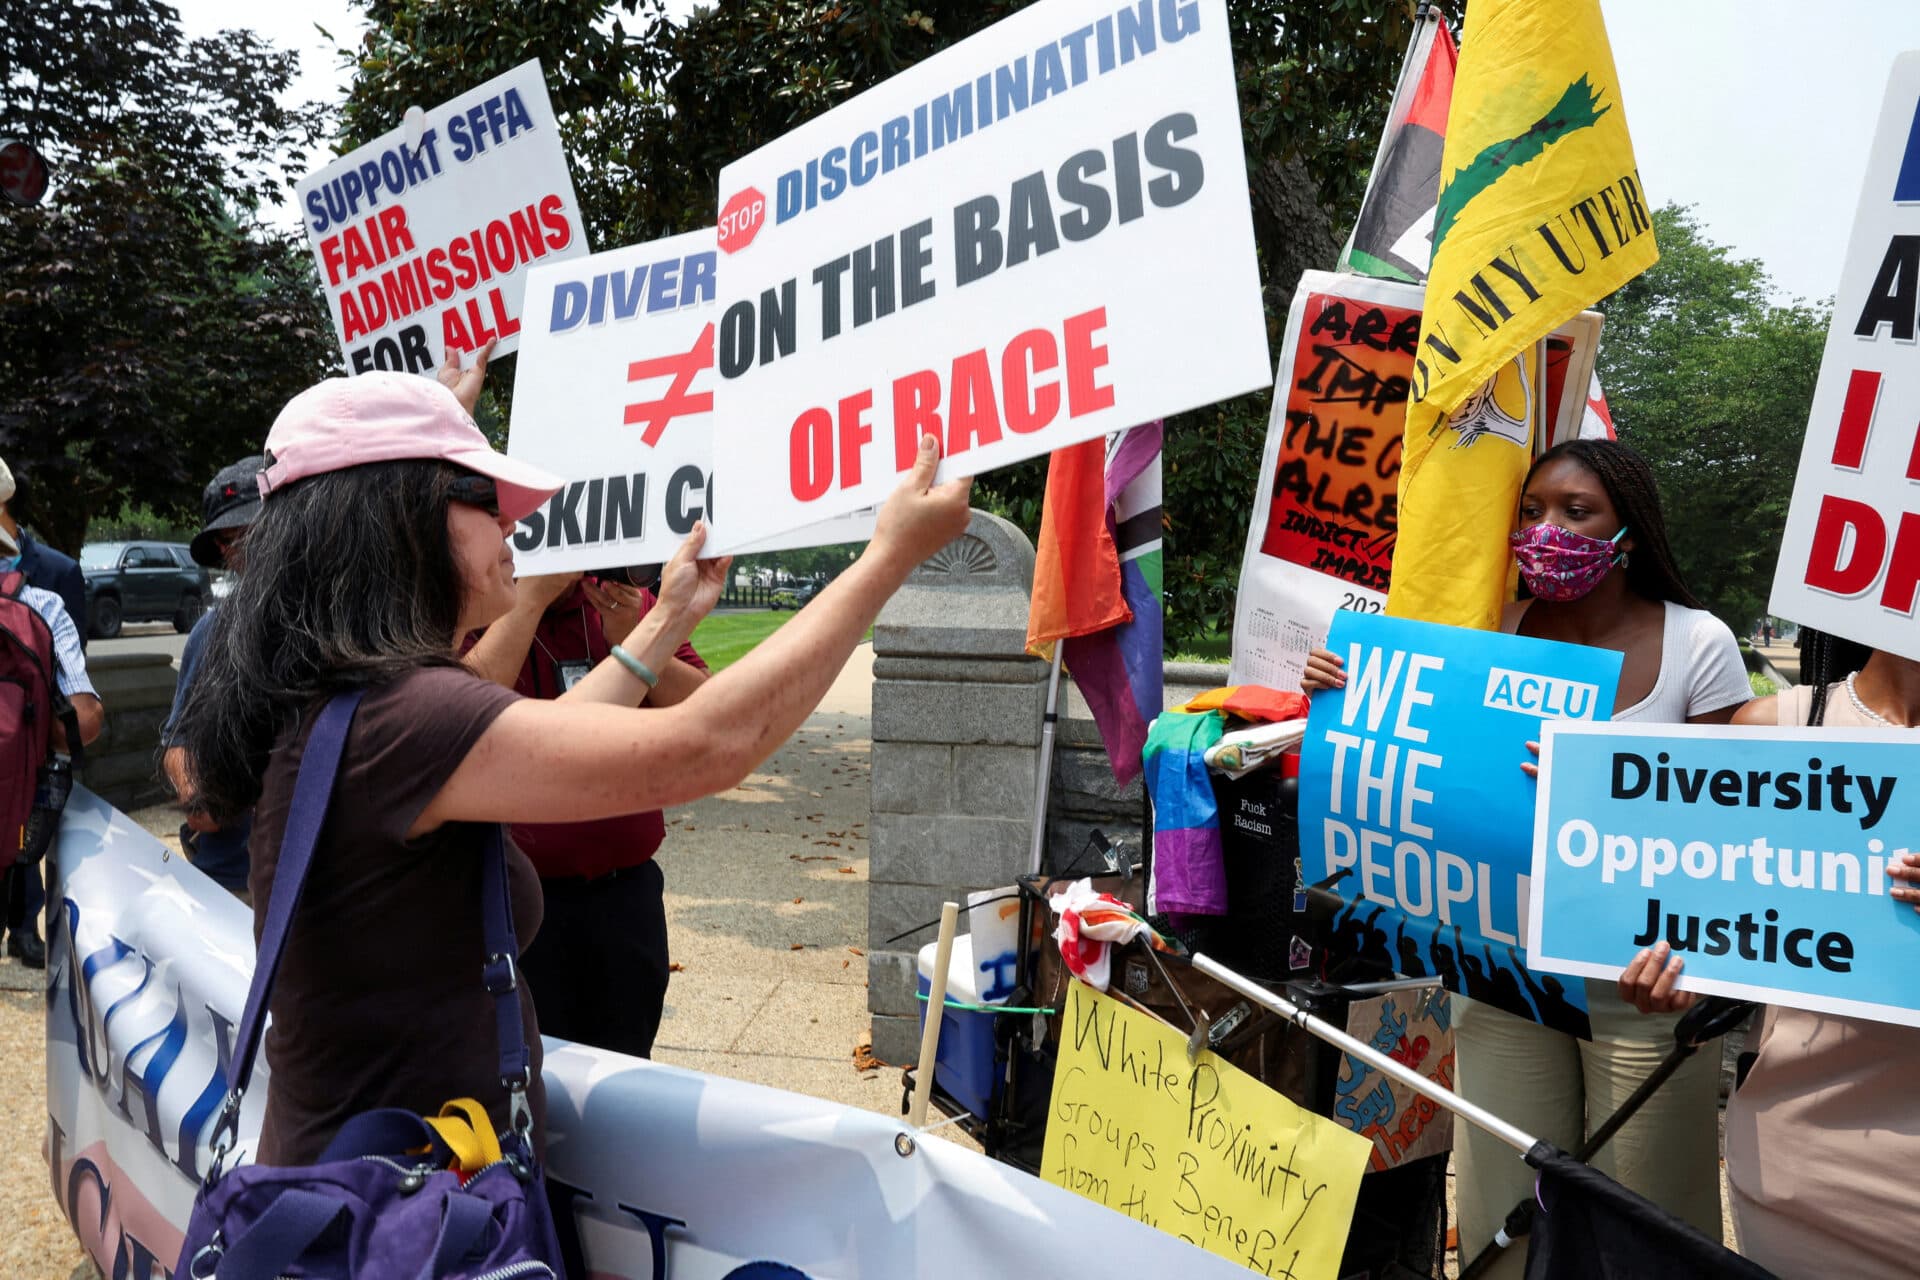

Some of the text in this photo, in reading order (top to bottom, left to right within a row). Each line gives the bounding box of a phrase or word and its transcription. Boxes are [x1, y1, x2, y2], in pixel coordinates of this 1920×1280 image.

[306, 87, 534, 233] SUPPORT SFFA
[719, 0, 1200, 241] STOP DISCRIMINATING
[319, 204, 415, 287] FAIR
[339, 194, 570, 343] ADMISSIONS
[719, 112, 1205, 379] ON THE BASIS
[1452, 244, 1543, 340] MY
[1536, 169, 1650, 275] UTER
[441, 287, 521, 356] ALL
[789, 306, 1115, 502] OF RACE
[1286, 410, 1376, 467] THE
[1339, 592, 1386, 614] 202
[1341, 642, 1445, 744] WE
[1489, 674, 1591, 719] ACLU
[1234, 814, 1272, 836] Racism
[1240, 799, 1267, 817] Fuck
[1325, 729, 1443, 840] THE
[1611, 752, 1898, 830] Diversity
[1634, 899, 1854, 973] Justice
[1056, 1067, 1156, 1171] Groups
[1075, 990, 1327, 1245] White Proximity
[1336, 1077, 1396, 1133] Say
[1057, 1133, 1109, 1205] from
